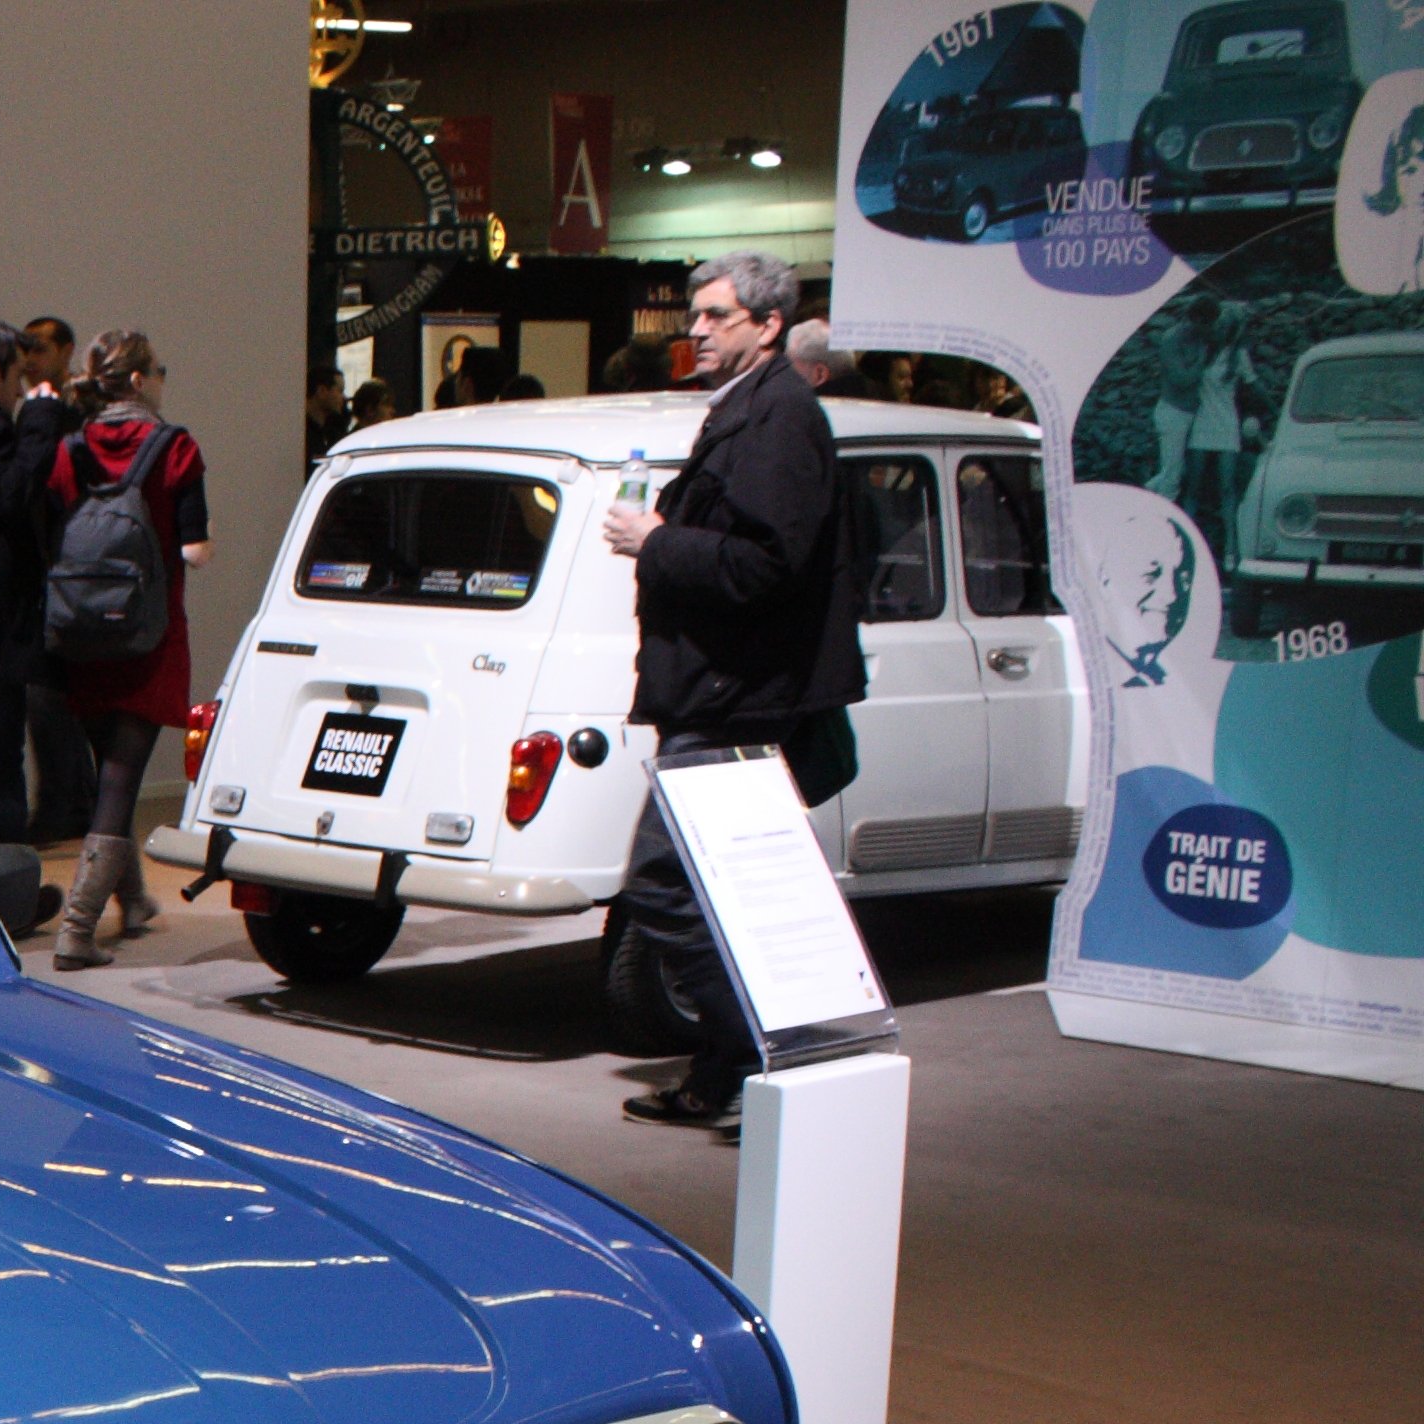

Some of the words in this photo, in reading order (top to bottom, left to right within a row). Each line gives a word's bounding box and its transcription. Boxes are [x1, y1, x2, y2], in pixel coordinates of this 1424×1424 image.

[924, 11, 998, 68] 1961
[338, 98, 458, 224] ARGENTEUIL
[558, 137, 603, 229] A
[1044, 175, 1155, 215] VENDUE
[335, 229, 480, 255] DIETRICH
[1042, 213, 1084, 236] DANS
[1085, 213, 1127, 234] PLUS
[1128, 212, 1152, 233] DE
[1042, 240, 1087, 270] 100
[1091, 236, 1151, 266] PAYS
[337, 262, 445, 344] BIRMINGHAM
[1270, 621, 1350, 664] 1968
[471, 654, 507, 676] Clan
[321, 727, 393, 756] RENAULT
[313, 750, 384, 779] CLASSIC
[1168, 831, 1231, 859] TRAIT
[1234, 837, 1266, 864] DE
[1165, 856, 1261, 904] GÉNIE
